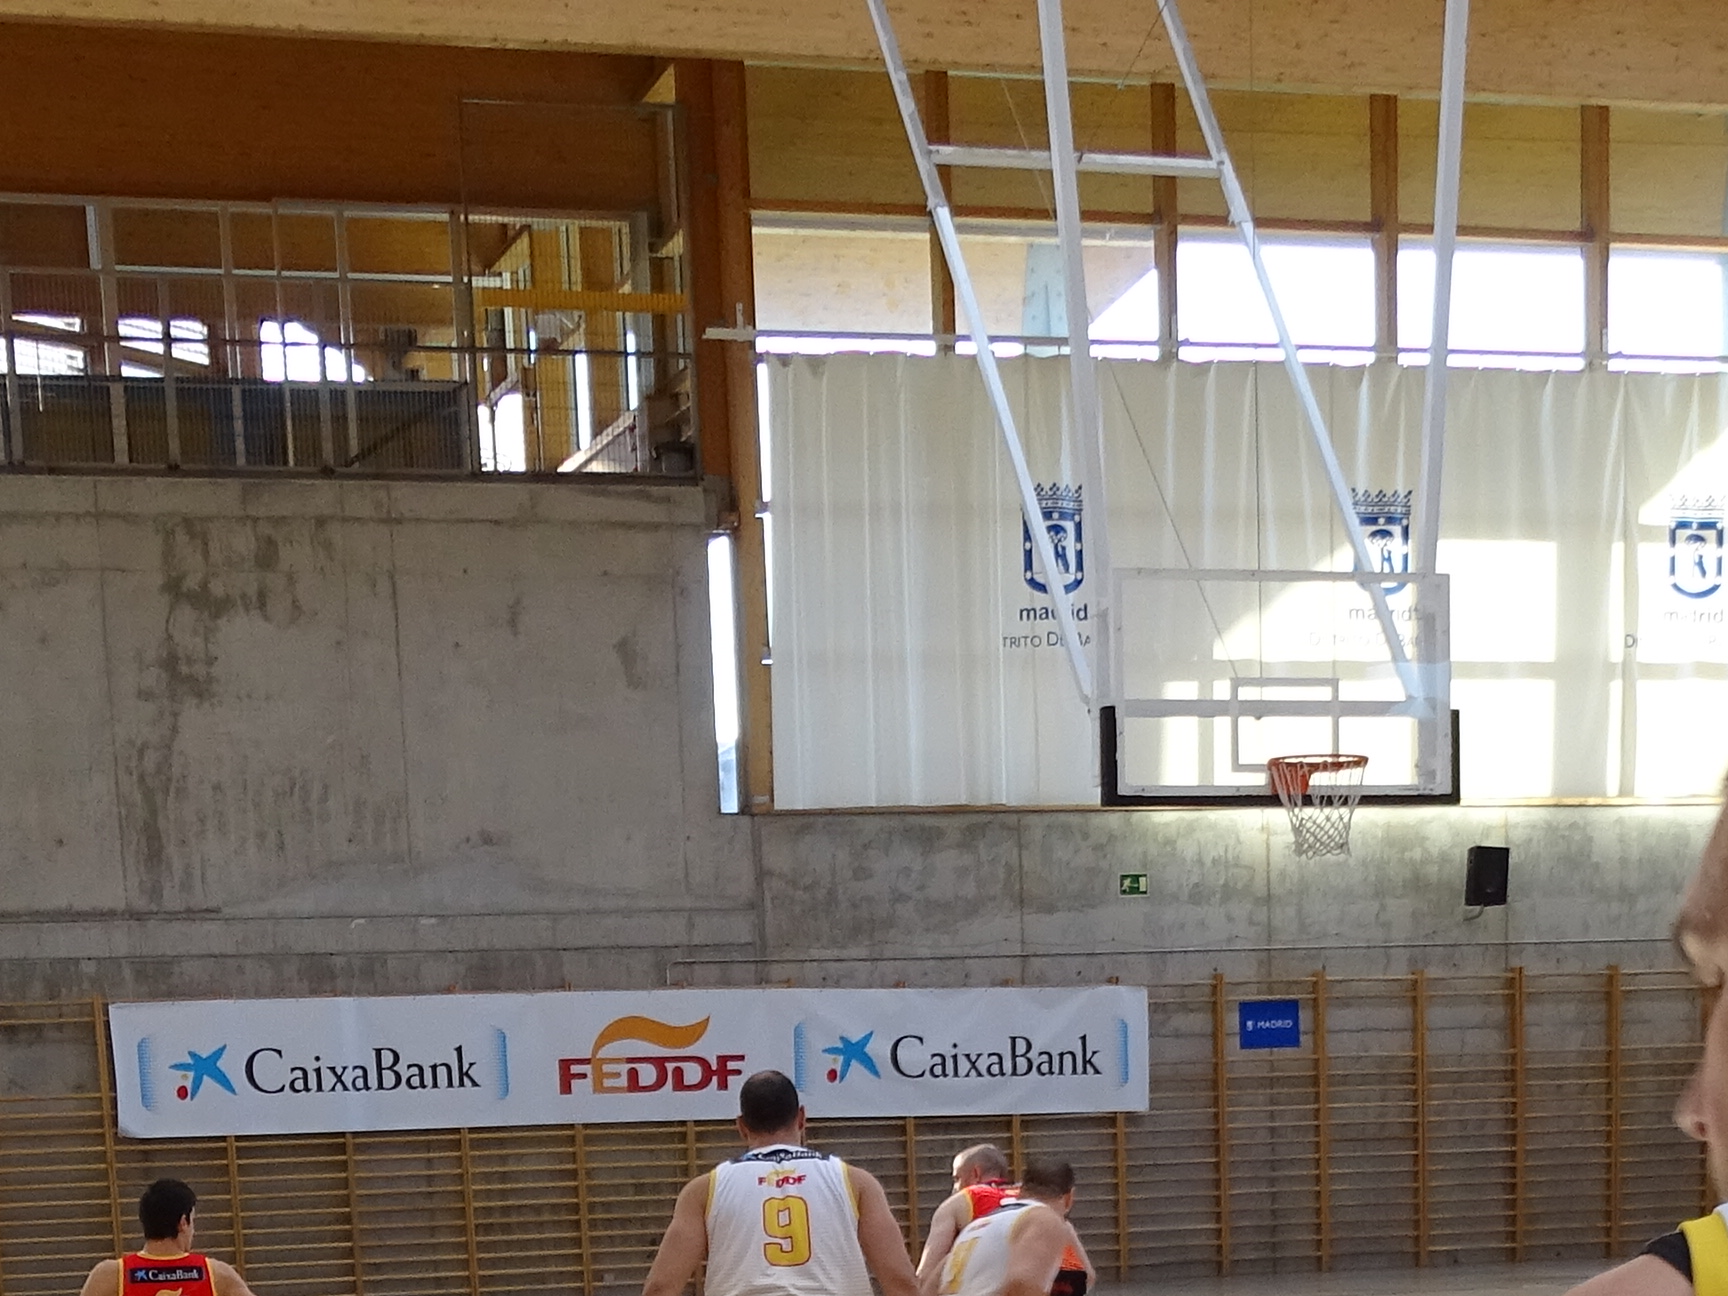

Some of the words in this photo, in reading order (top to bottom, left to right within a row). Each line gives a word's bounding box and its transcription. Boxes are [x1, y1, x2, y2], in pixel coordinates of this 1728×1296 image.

[244, 1044, 482, 1095] CaixaBank
[558, 1054, 746, 1096] FEDDF
[889, 1033, 1103, 1079] CaixaBank
[762, 1195, 812, 1267] 9
